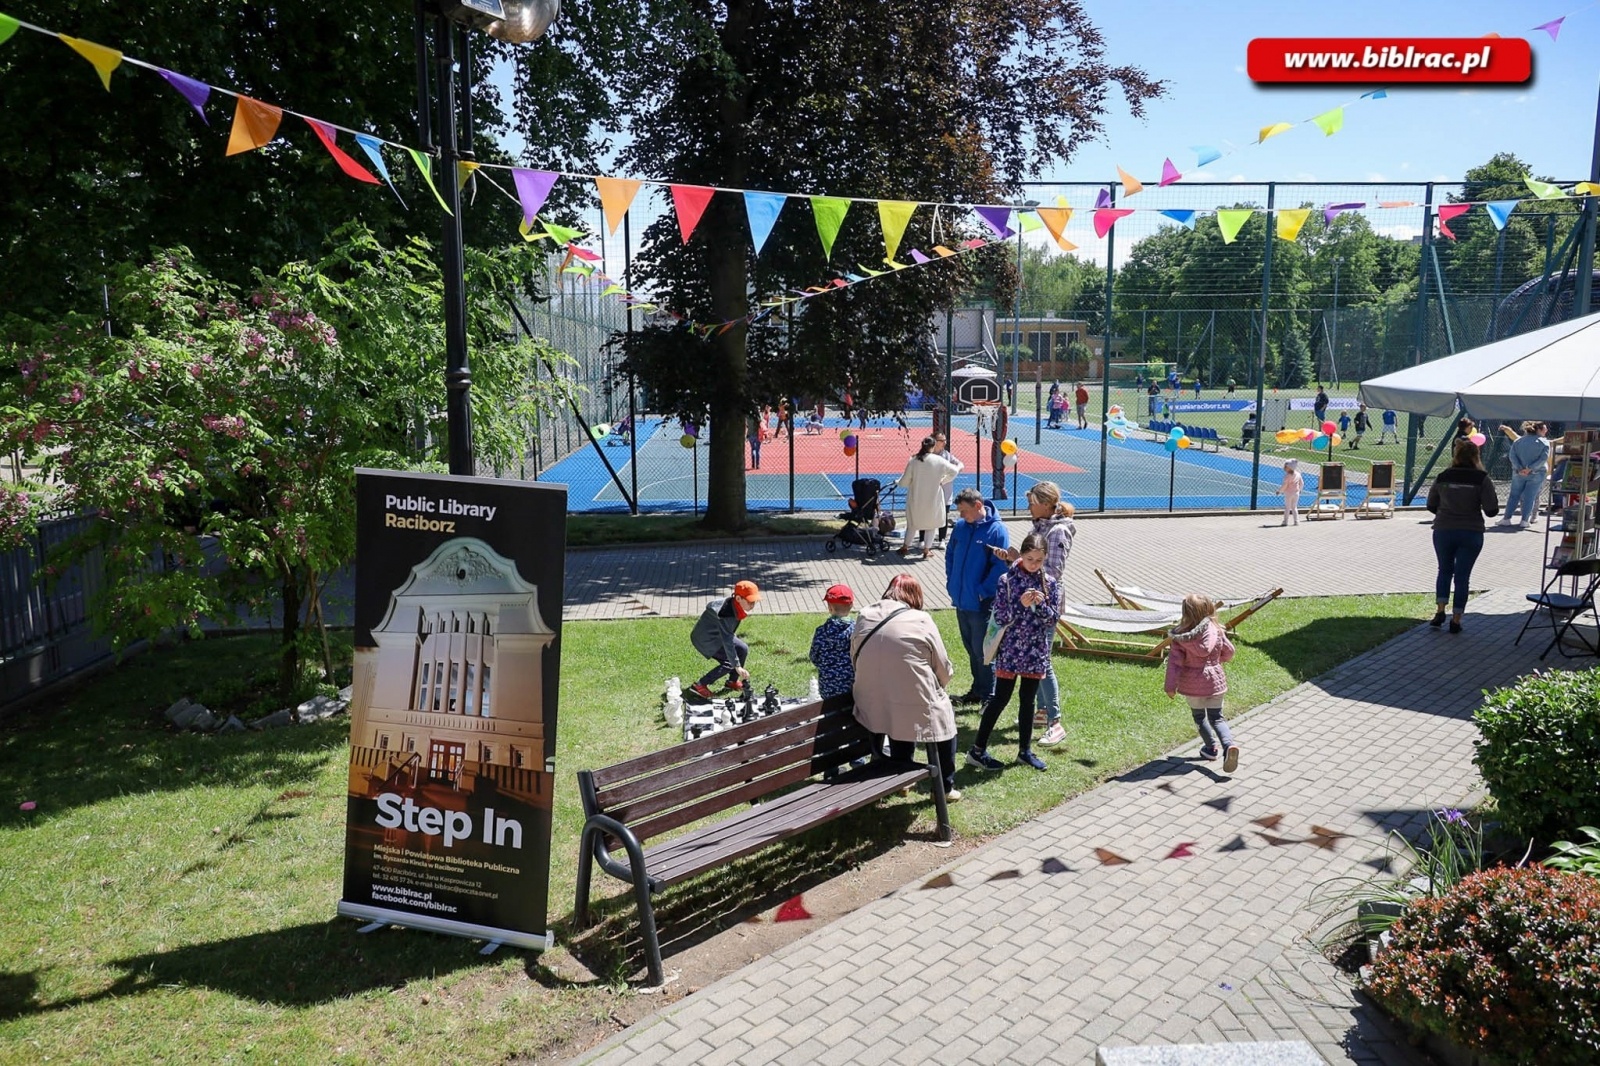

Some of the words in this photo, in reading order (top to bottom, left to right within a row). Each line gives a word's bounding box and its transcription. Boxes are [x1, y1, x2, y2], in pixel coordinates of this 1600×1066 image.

[385, 494, 435, 515] Public
[438, 497, 497, 521] Library
[385, 513, 456, 534] Raciborz
[375, 792, 473, 848] Step
[483, 808, 523, 849] In
[373, 844, 401, 855] Miejska
[404, 849, 445, 863] Powiatowa
[445, 855, 483, 869] Biblioteka
[483, 861, 520, 875] Publiczna
[382, 854, 409, 865] Ryszarda
[434, 863, 465, 874] Raciborzu
[425, 873, 439, 881] Jana
[439, 875, 475, 888] Kasprowicza
[371, 884, 433, 901] www.biblrac.pl
[371, 891, 458, 913] facebook.com/biblrac
